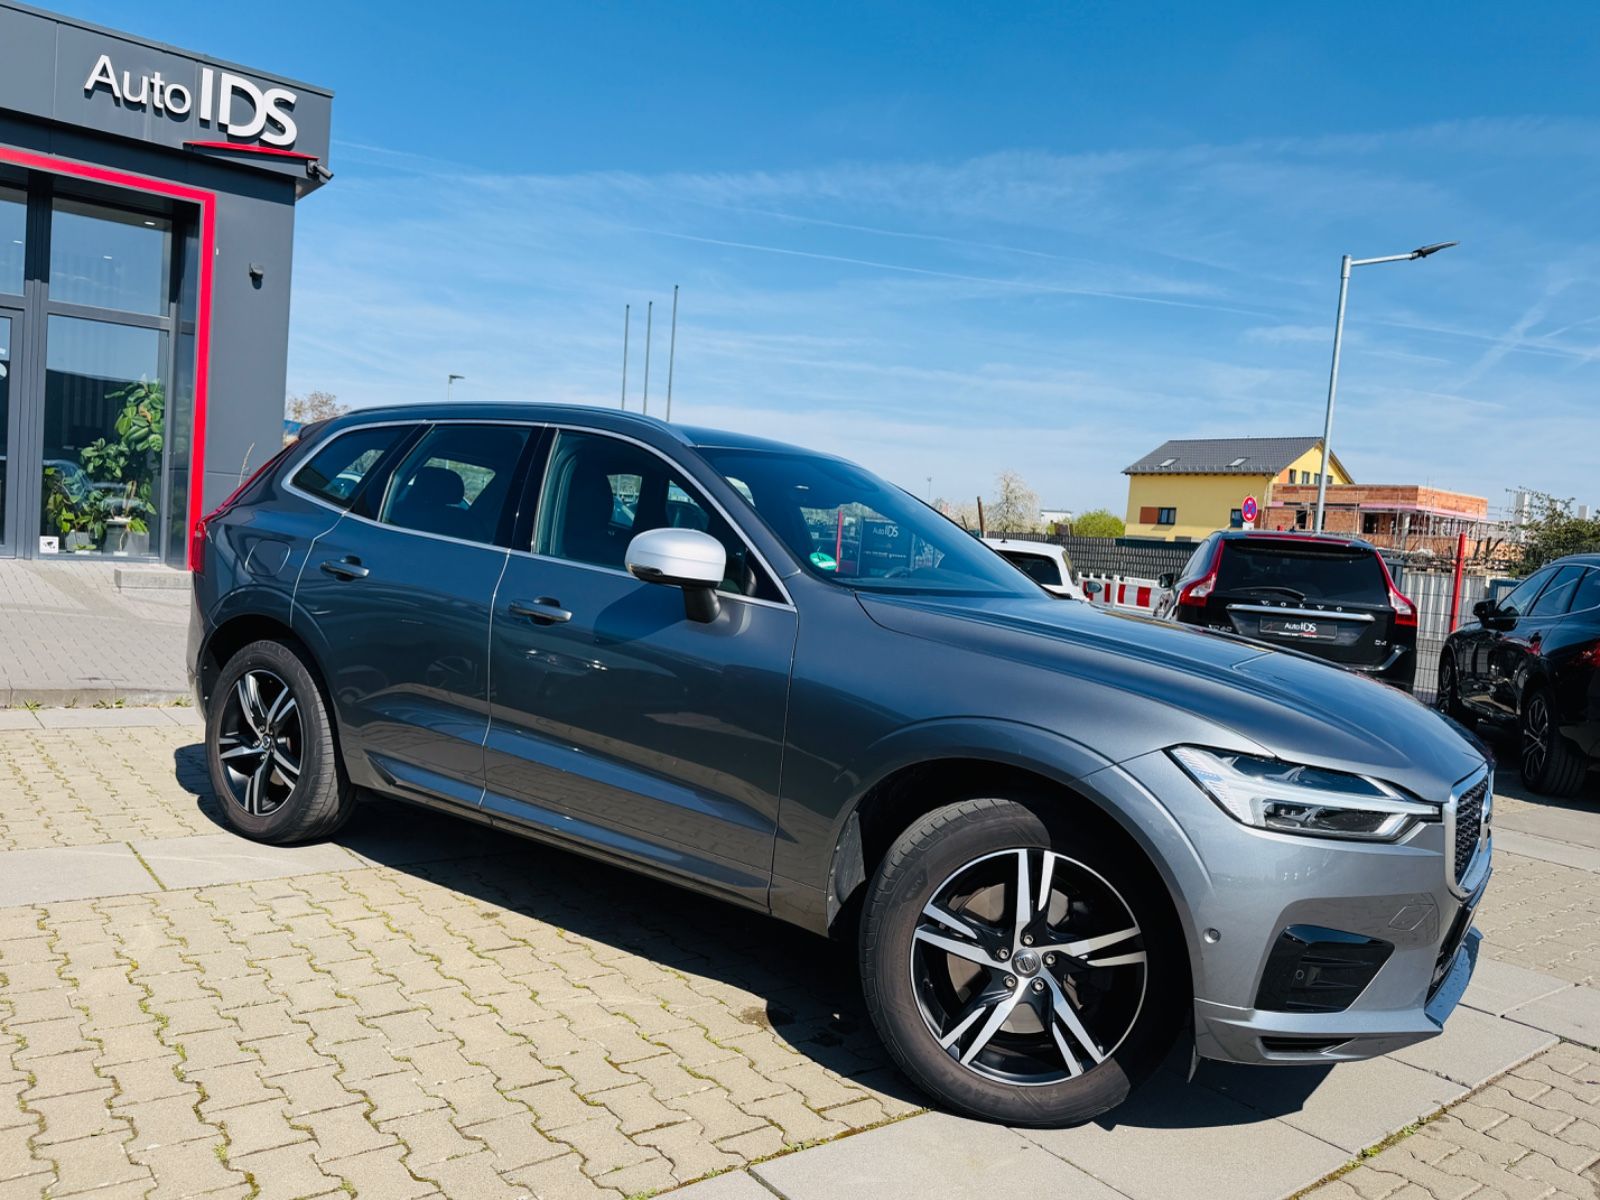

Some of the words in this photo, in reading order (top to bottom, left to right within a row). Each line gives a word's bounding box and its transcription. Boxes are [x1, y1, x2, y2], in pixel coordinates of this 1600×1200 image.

[84, 55, 192, 114] Auto
[199, 68, 298, 146] IDS
[1261, 600, 1343, 613] VOLVO
